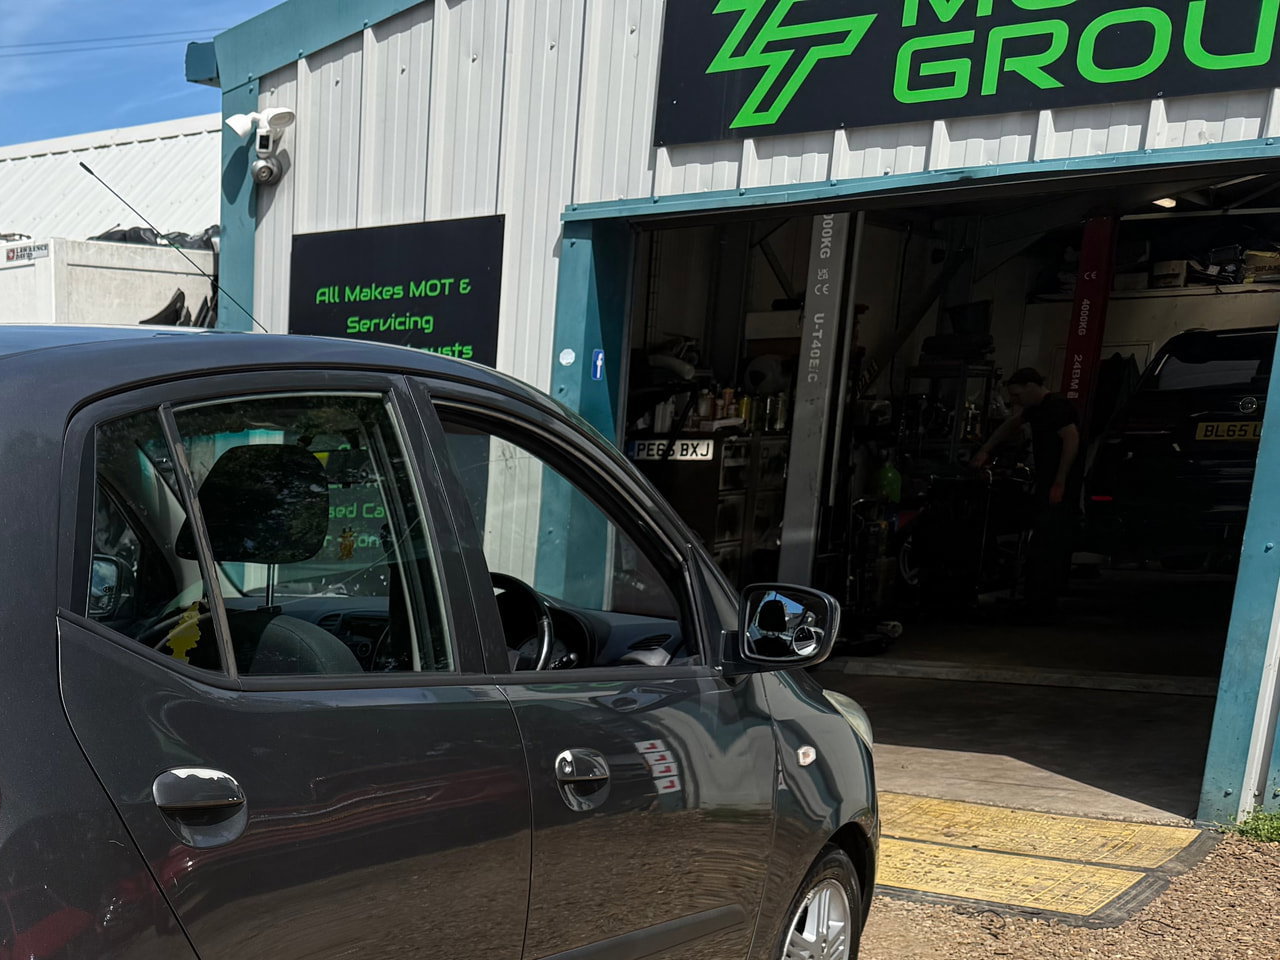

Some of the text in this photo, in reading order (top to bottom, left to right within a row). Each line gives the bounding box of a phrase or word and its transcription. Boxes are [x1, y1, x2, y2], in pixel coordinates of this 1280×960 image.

[316, 278, 471, 304] All Makes MOT &
[346, 312, 434, 333] Servicing
[1203, 424, 1249, 438] BL65
[679, 442, 710, 457] BXJ
